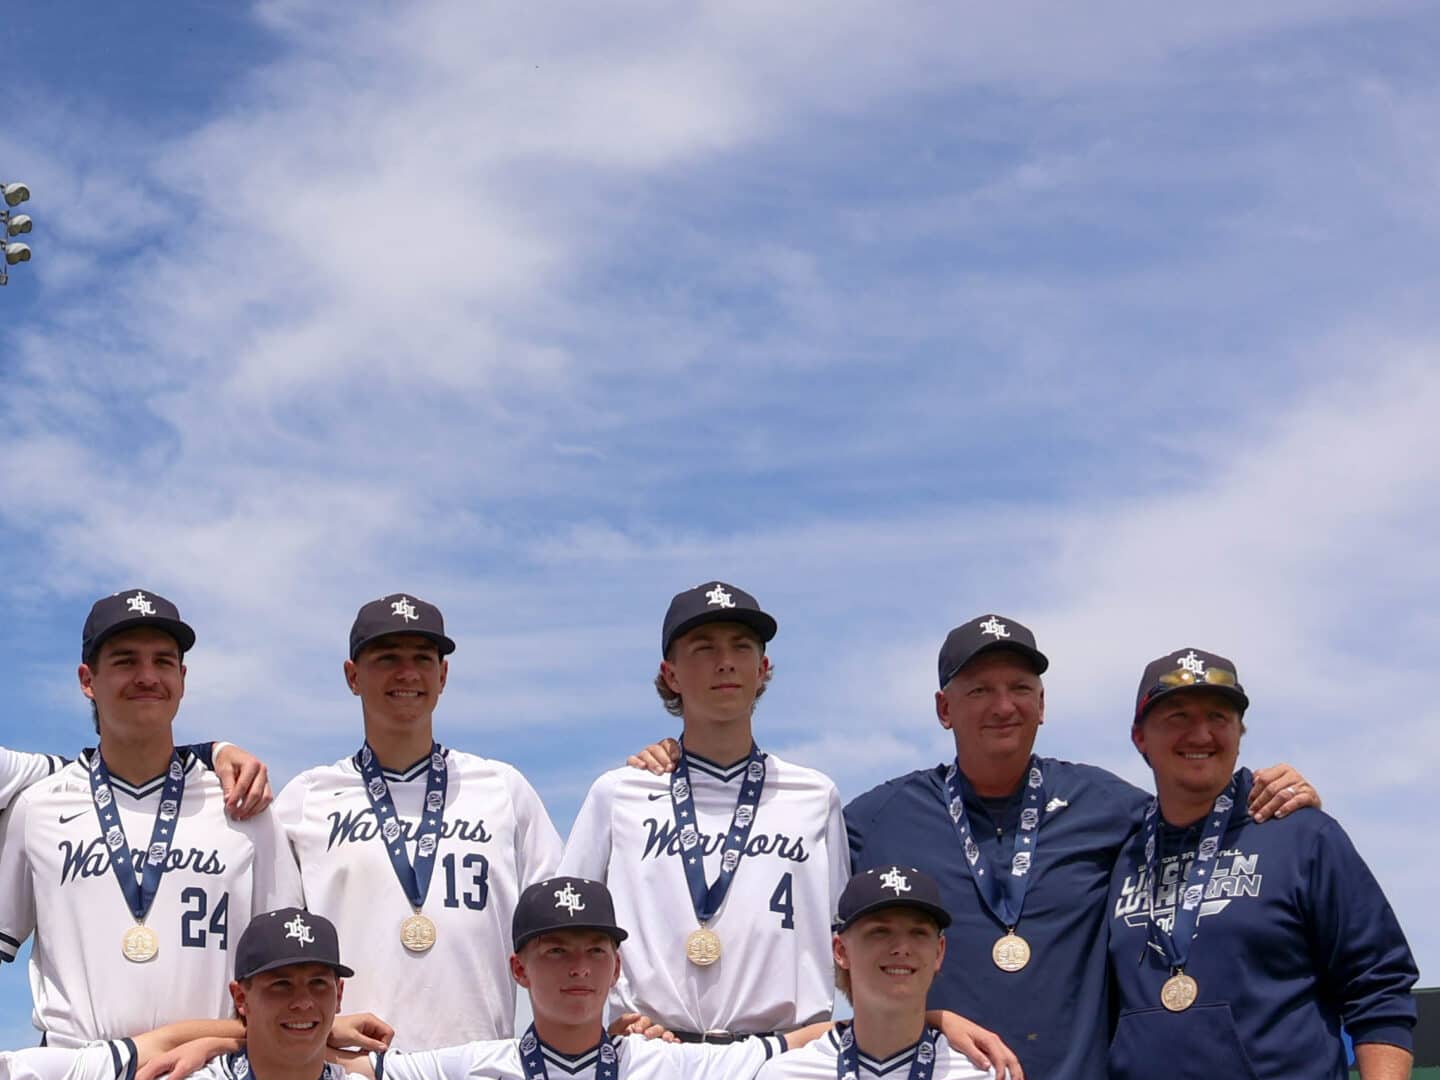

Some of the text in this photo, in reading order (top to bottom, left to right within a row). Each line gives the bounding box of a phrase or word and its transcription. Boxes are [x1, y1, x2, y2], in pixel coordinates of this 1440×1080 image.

[326, 807, 493, 853] Warrs
[640, 817, 810, 863] Warors
[58, 836, 227, 887] Warors
[442, 852, 490, 911] 13
[180, 886, 230, 950] 24
[768, 871, 795, 930] 4
